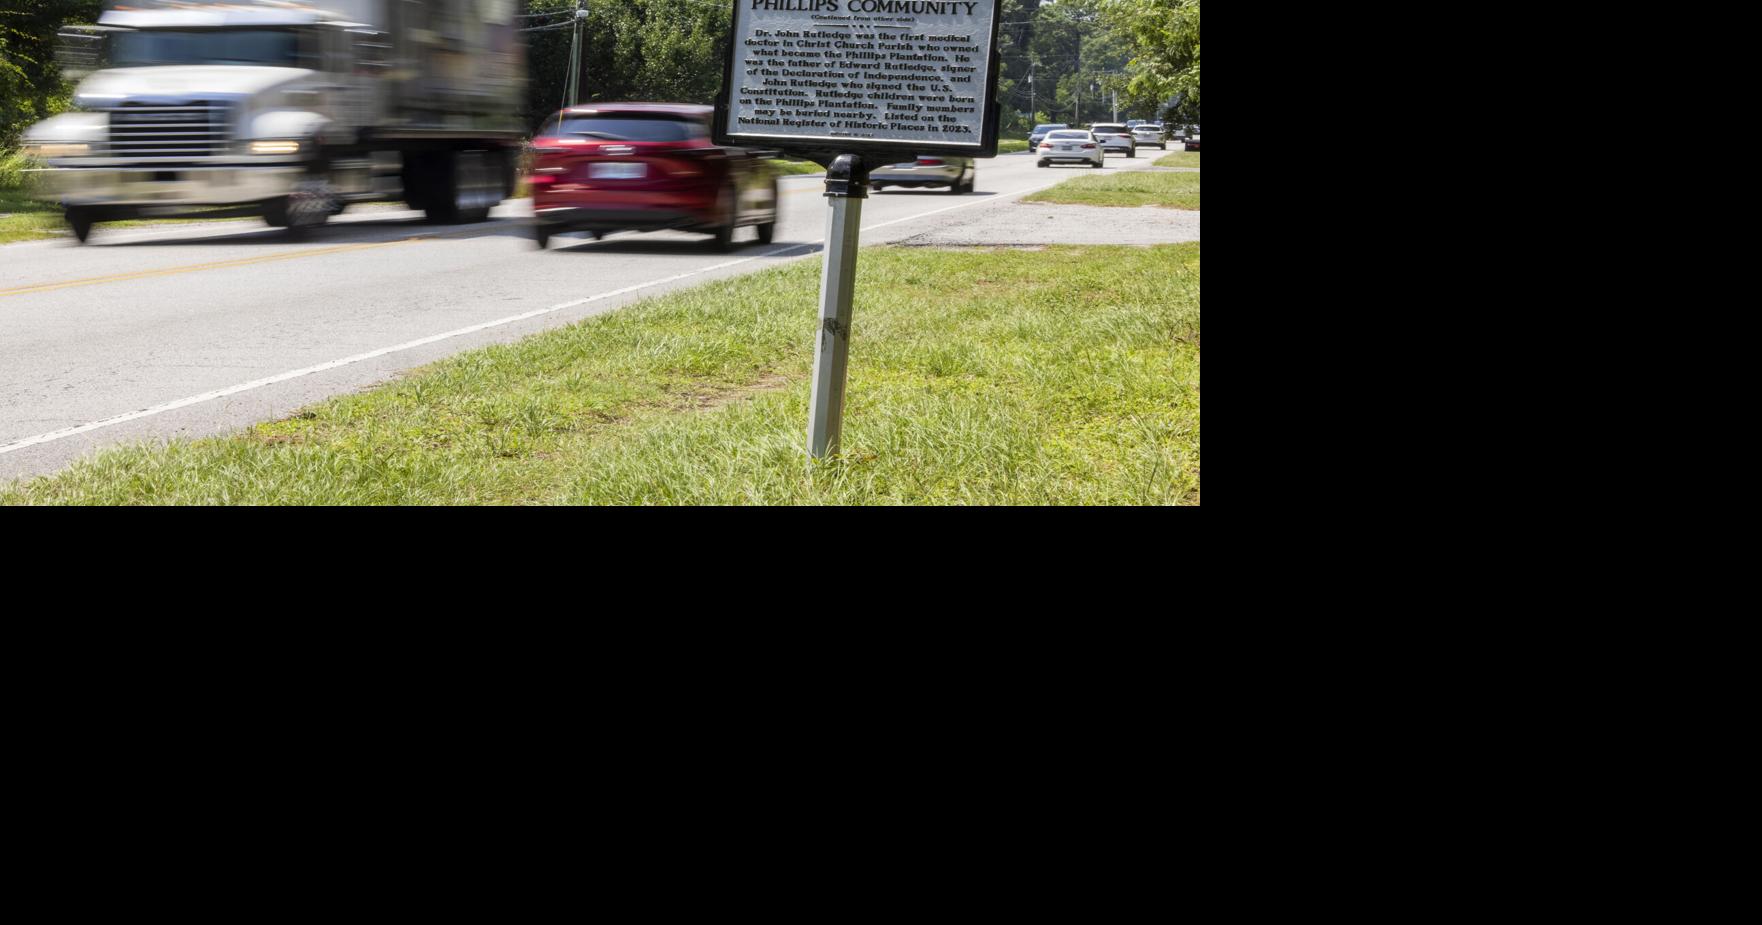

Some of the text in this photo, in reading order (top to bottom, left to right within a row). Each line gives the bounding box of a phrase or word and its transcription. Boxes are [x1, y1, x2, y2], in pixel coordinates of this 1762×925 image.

[752, 0, 978, 15] PHILLIPS COMMUNITY
[755, 29, 772, 37] Dr.
[803, 31, 851, 40] Rutledge
[901, 33, 924, 41] first
[929, 34, 970, 42] medical
[797, 40, 831, 48] Christ
[834, 41, 874, 49] Church
[879, 43, 913, 51] Parish
[944, 45, 979, 53] owned
[782, 49, 820, 57] became
[846, 51, 886, 60] Phillips
[890, 53, 948, 61] Plantation.
[761, 68, 778, 76] the
[782, 69, 844, 78] Declaration
[788, 60, 821, 68] father
[840, 61, 880, 69] Edward
[941, 64, 976, 73] signer
[763, 78, 787, 86] John
[791, 79, 837, 88] Rutledge
[866, 82, 902, 91] signed
[907, 83, 925, 91] the
[931, 84, 952, 92] U.S.
[740, 87, 808, 96] Constitution.
[816, 89, 863, 99] Rutledge
[868, 92, 914, 100] children
[949, 95, 974, 103] born
[776, 98, 814, 108] Phillips
[818, 100, 878, 109] Plantation.
[887, 102, 923, 112] Family
[927, 104, 974, 112] members
[796, 109, 830, 117] buried
[834, 111, 876, 120] nearby.
[885, 113, 917, 121] Listed
[938, 115, 957, 123] the
[738, 117, 779, 125] National
[783, 119, 827, 127] Register
[845, 121, 888, 130] Historic
[891, 123, 925, 131] Places
[928, 124, 939, 132] in
[943, 125, 971, 134] 2023.
